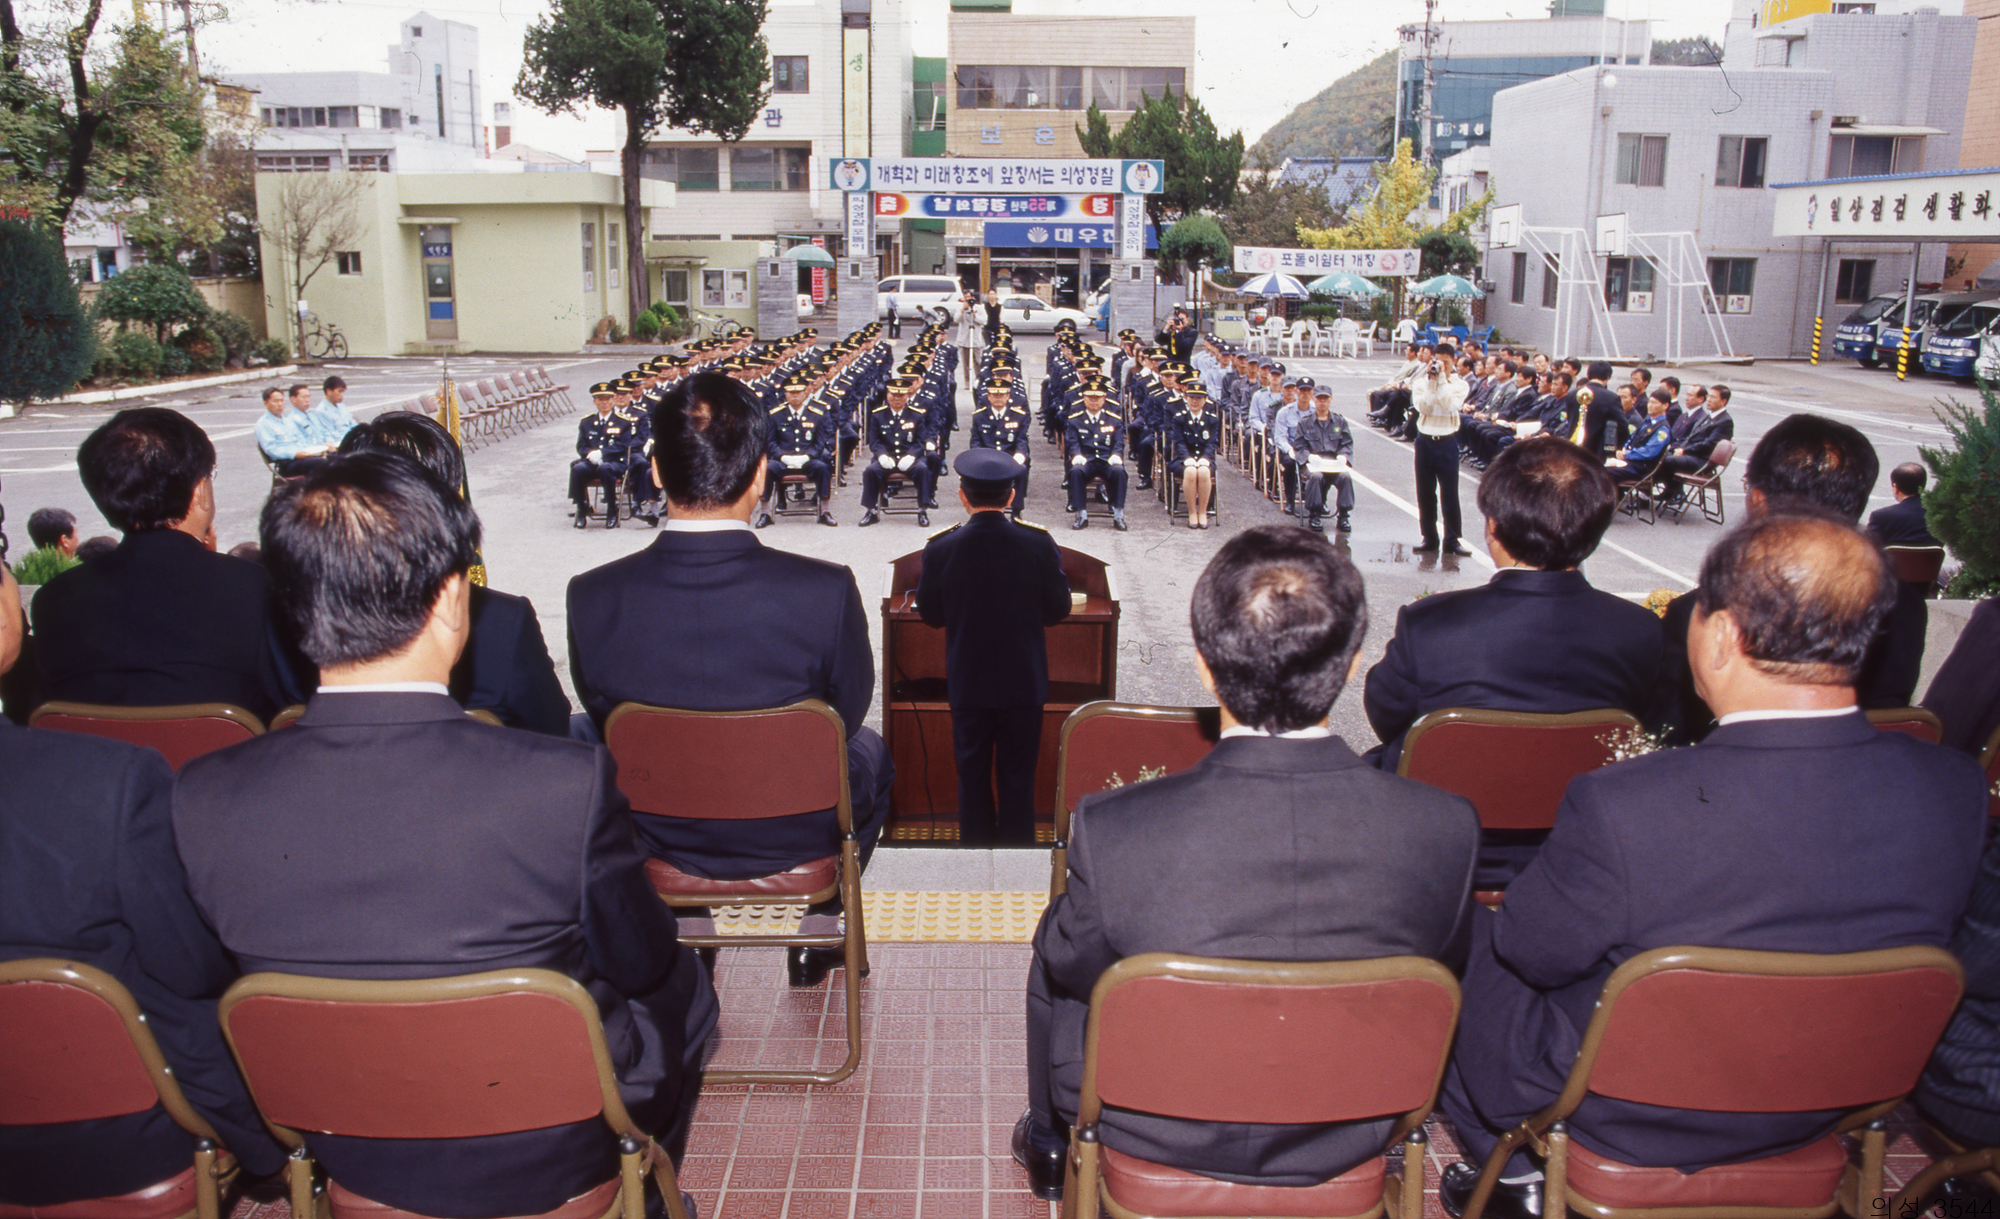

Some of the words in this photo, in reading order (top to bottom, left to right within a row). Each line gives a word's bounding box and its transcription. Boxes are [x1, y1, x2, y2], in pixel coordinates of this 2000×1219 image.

[878, 165, 919, 184] 개혁과
[925, 165, 993, 184] 미래창조에
[1001, 166, 1054, 184] 앞장서는
[1061, 166, 1114, 186] 의성경찰
[1830, 194, 1908, 222] 일상점검
[1922, 190, 2000, 221] 생활화
[1281, 253, 1345, 267] 포돌이쉼터
[1352, 254, 1376, 267] 개장
